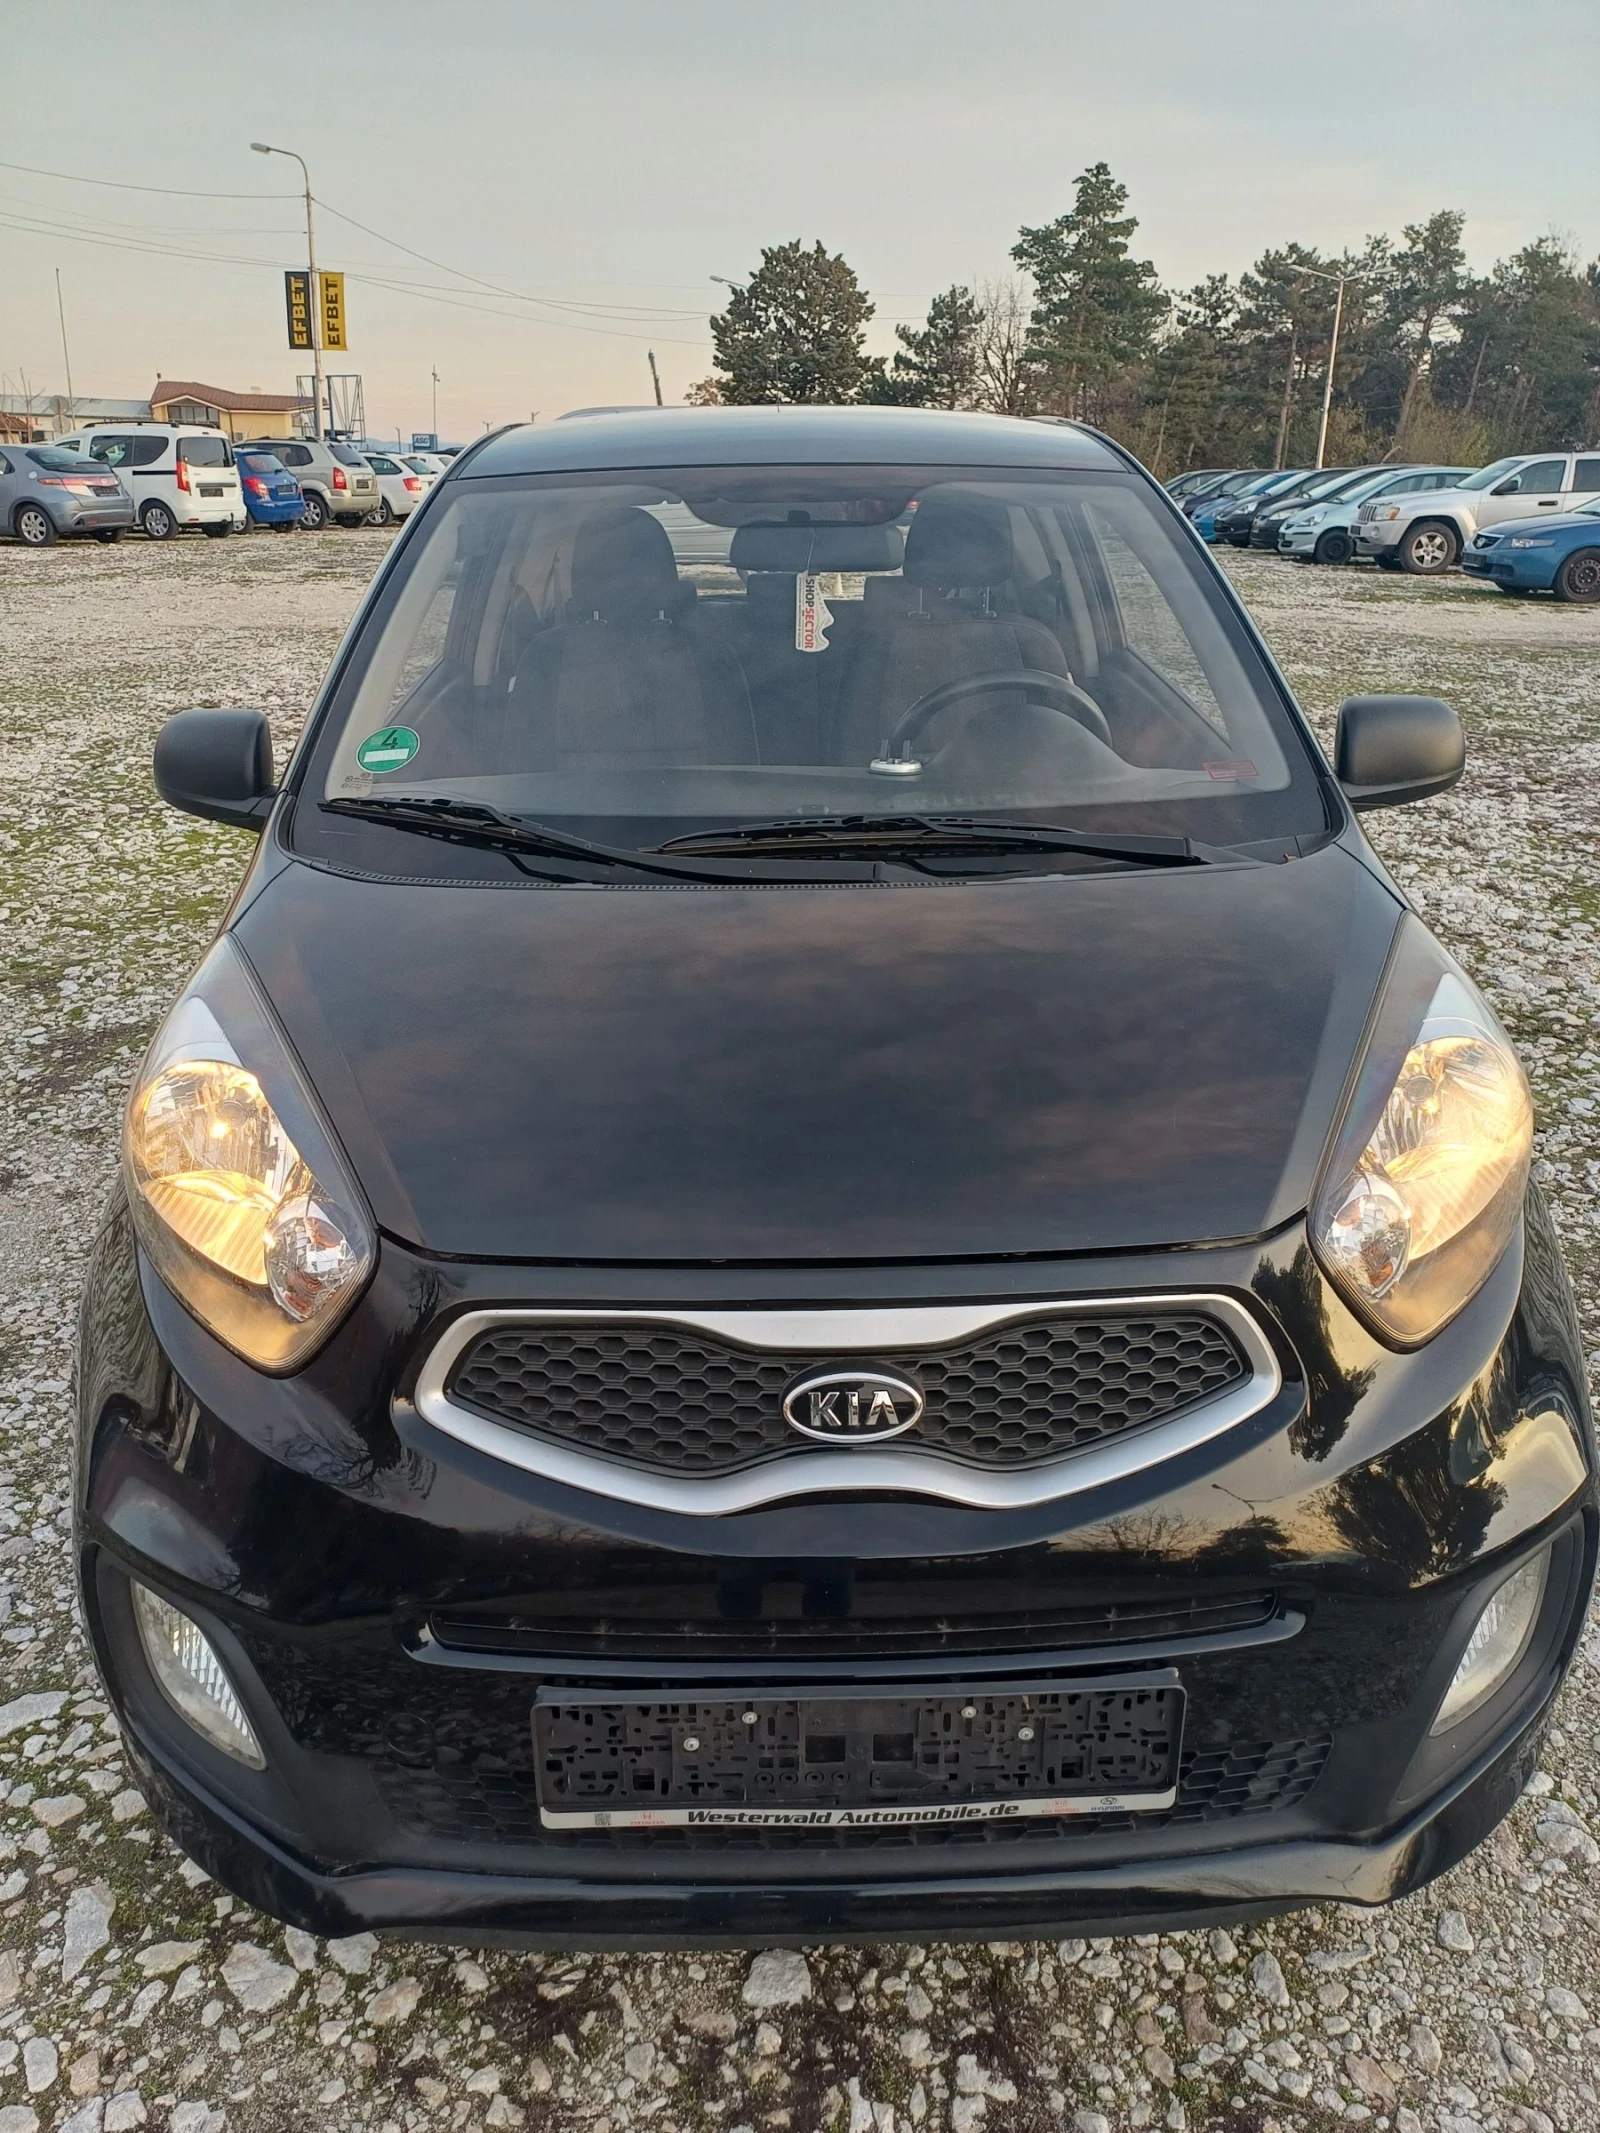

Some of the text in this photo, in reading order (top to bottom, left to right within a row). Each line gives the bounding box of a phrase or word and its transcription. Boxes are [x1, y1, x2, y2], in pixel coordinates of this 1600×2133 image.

[289, 276, 307, 345] EFBET
[325, 277, 340, 345] EFBET
[381, 729, 398, 749] 4
[808, 1390, 899, 1427] KIA
[688, 1803, 1019, 1824] Westerwald Automobile.de
